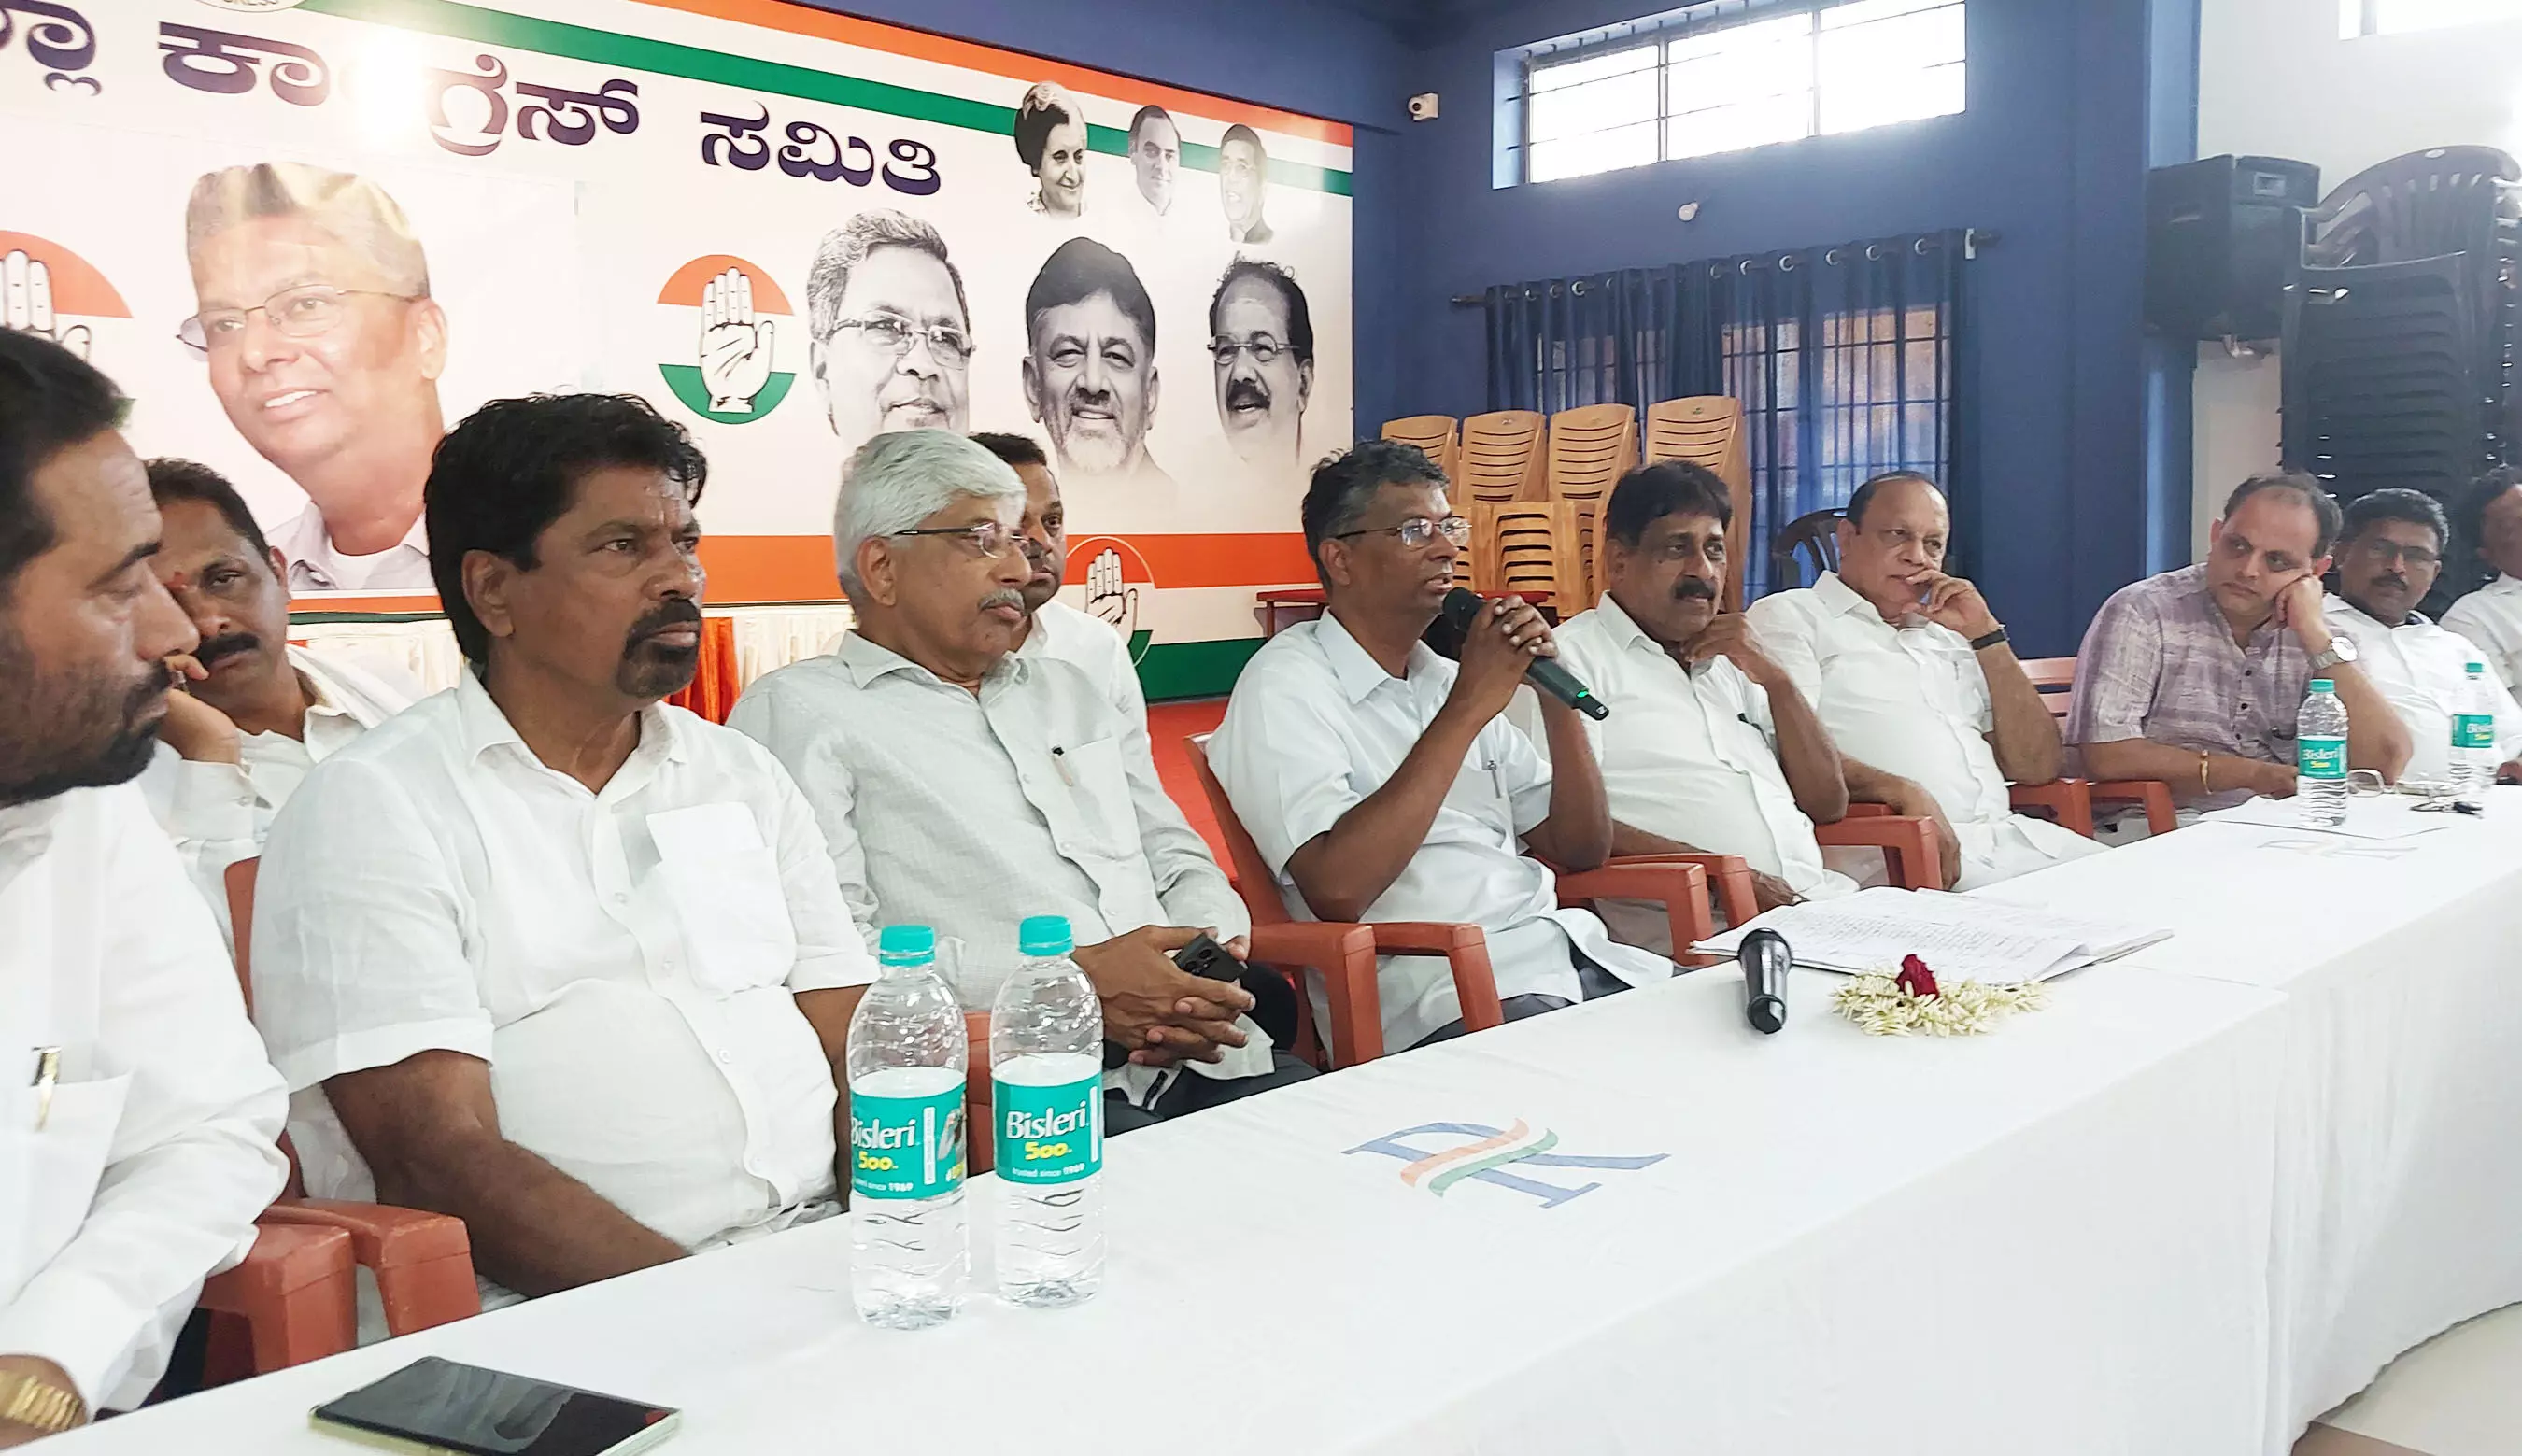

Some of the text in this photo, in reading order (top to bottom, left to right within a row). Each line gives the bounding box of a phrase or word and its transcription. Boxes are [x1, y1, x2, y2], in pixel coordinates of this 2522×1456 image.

[158, 21, 640, 157] ಕಾಗ್ರೆಸ್
[700, 100, 942, 196] ಸಮಿತಿ
[1006, 1100, 1086, 1139] Bisleri
